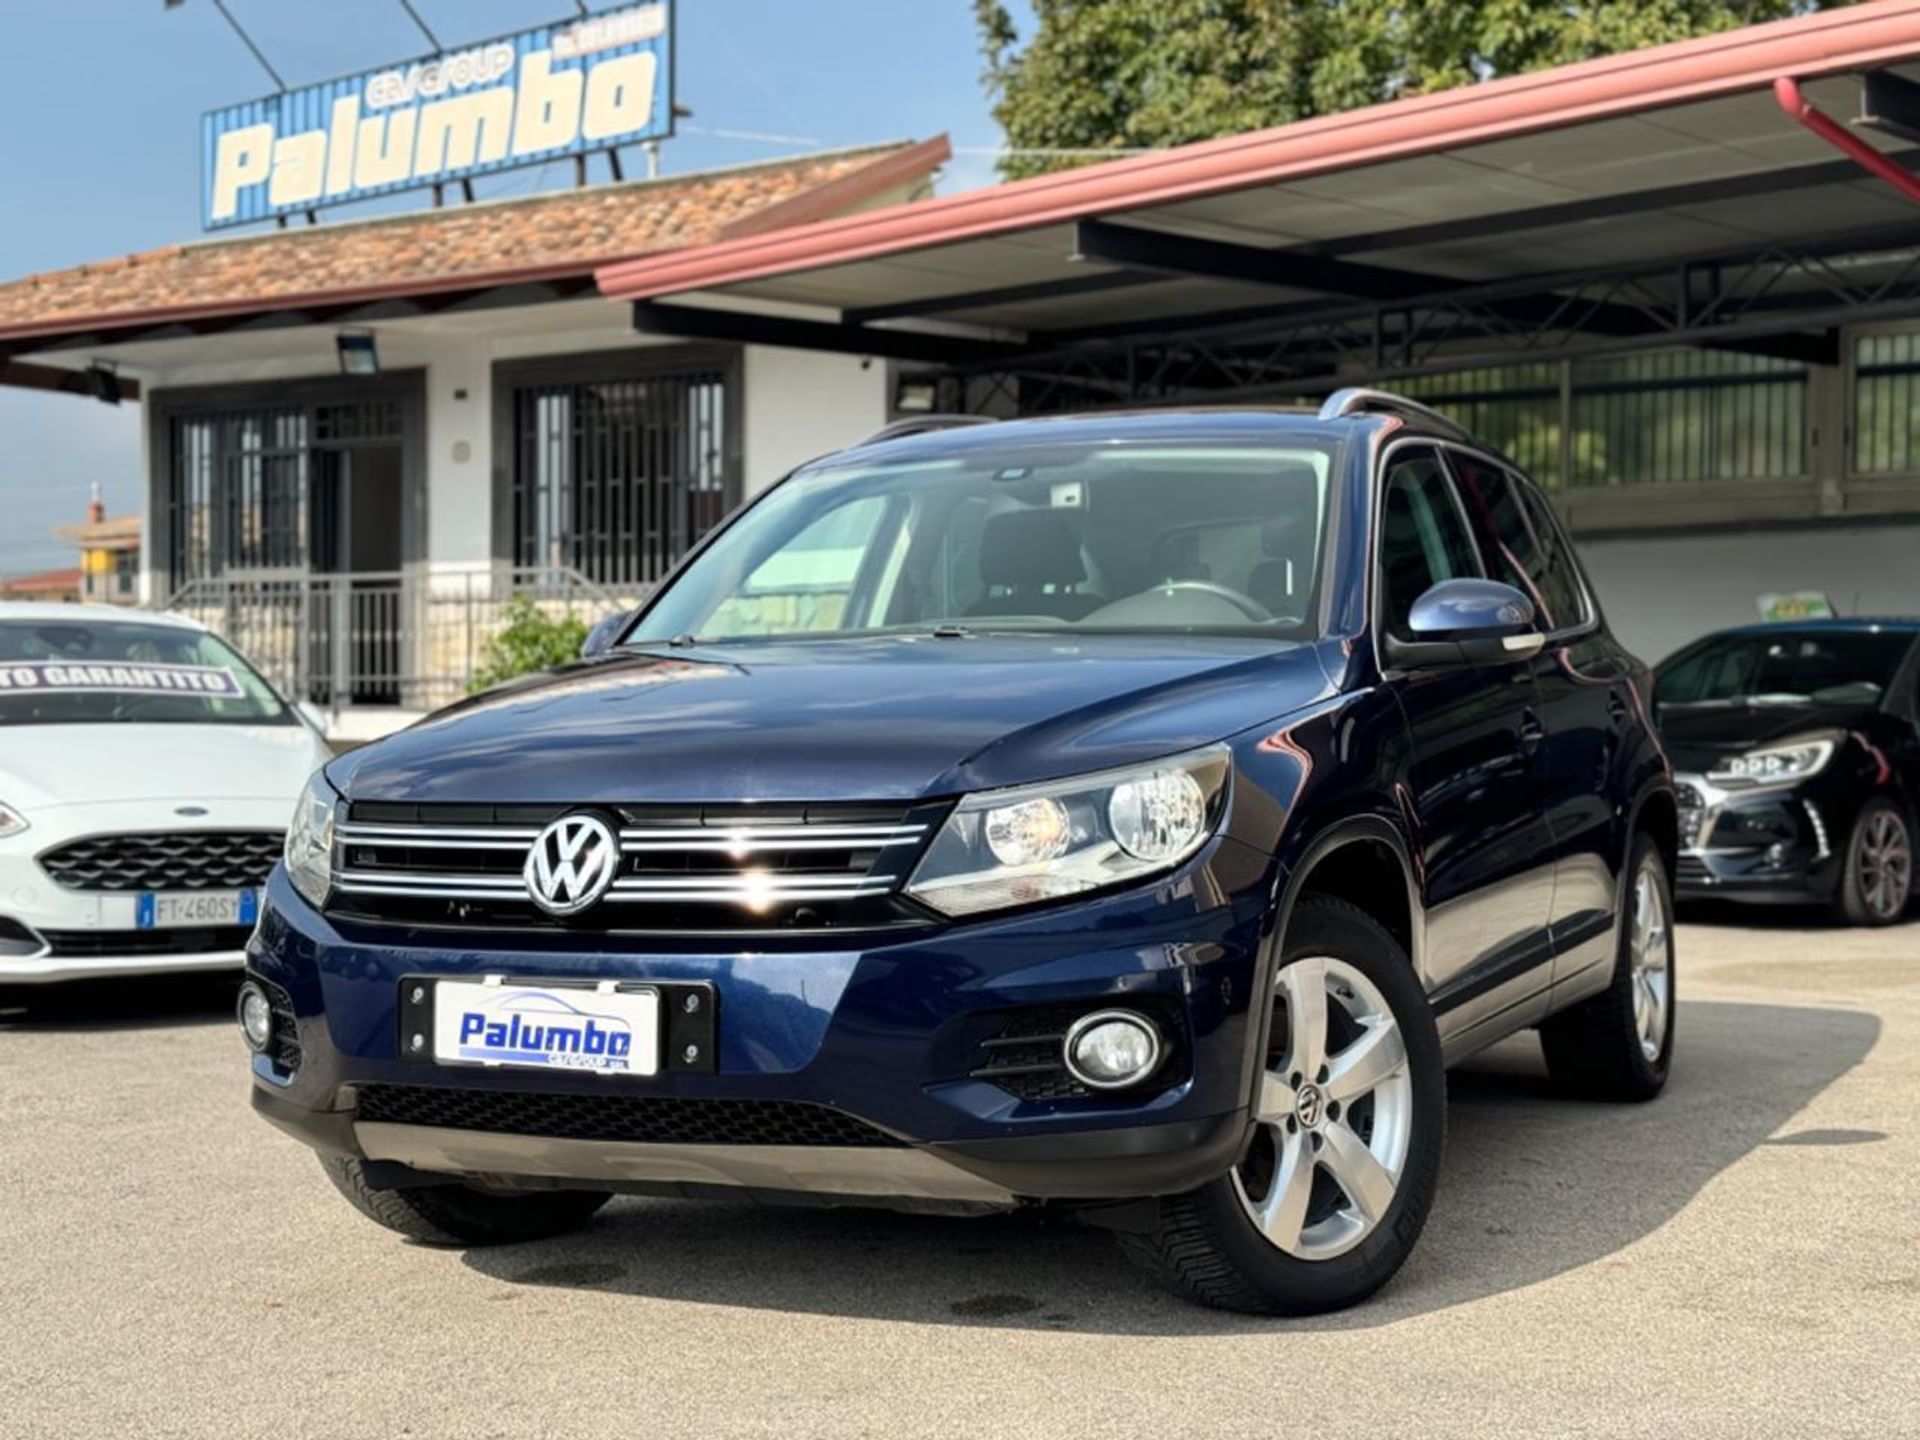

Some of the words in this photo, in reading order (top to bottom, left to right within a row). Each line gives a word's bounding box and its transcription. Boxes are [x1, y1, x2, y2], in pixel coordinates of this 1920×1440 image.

[212, 50, 656, 219] Palumbo
[43, 667, 227, 690] GARANTITO
[460, 1012, 630, 1056] Palumbo
